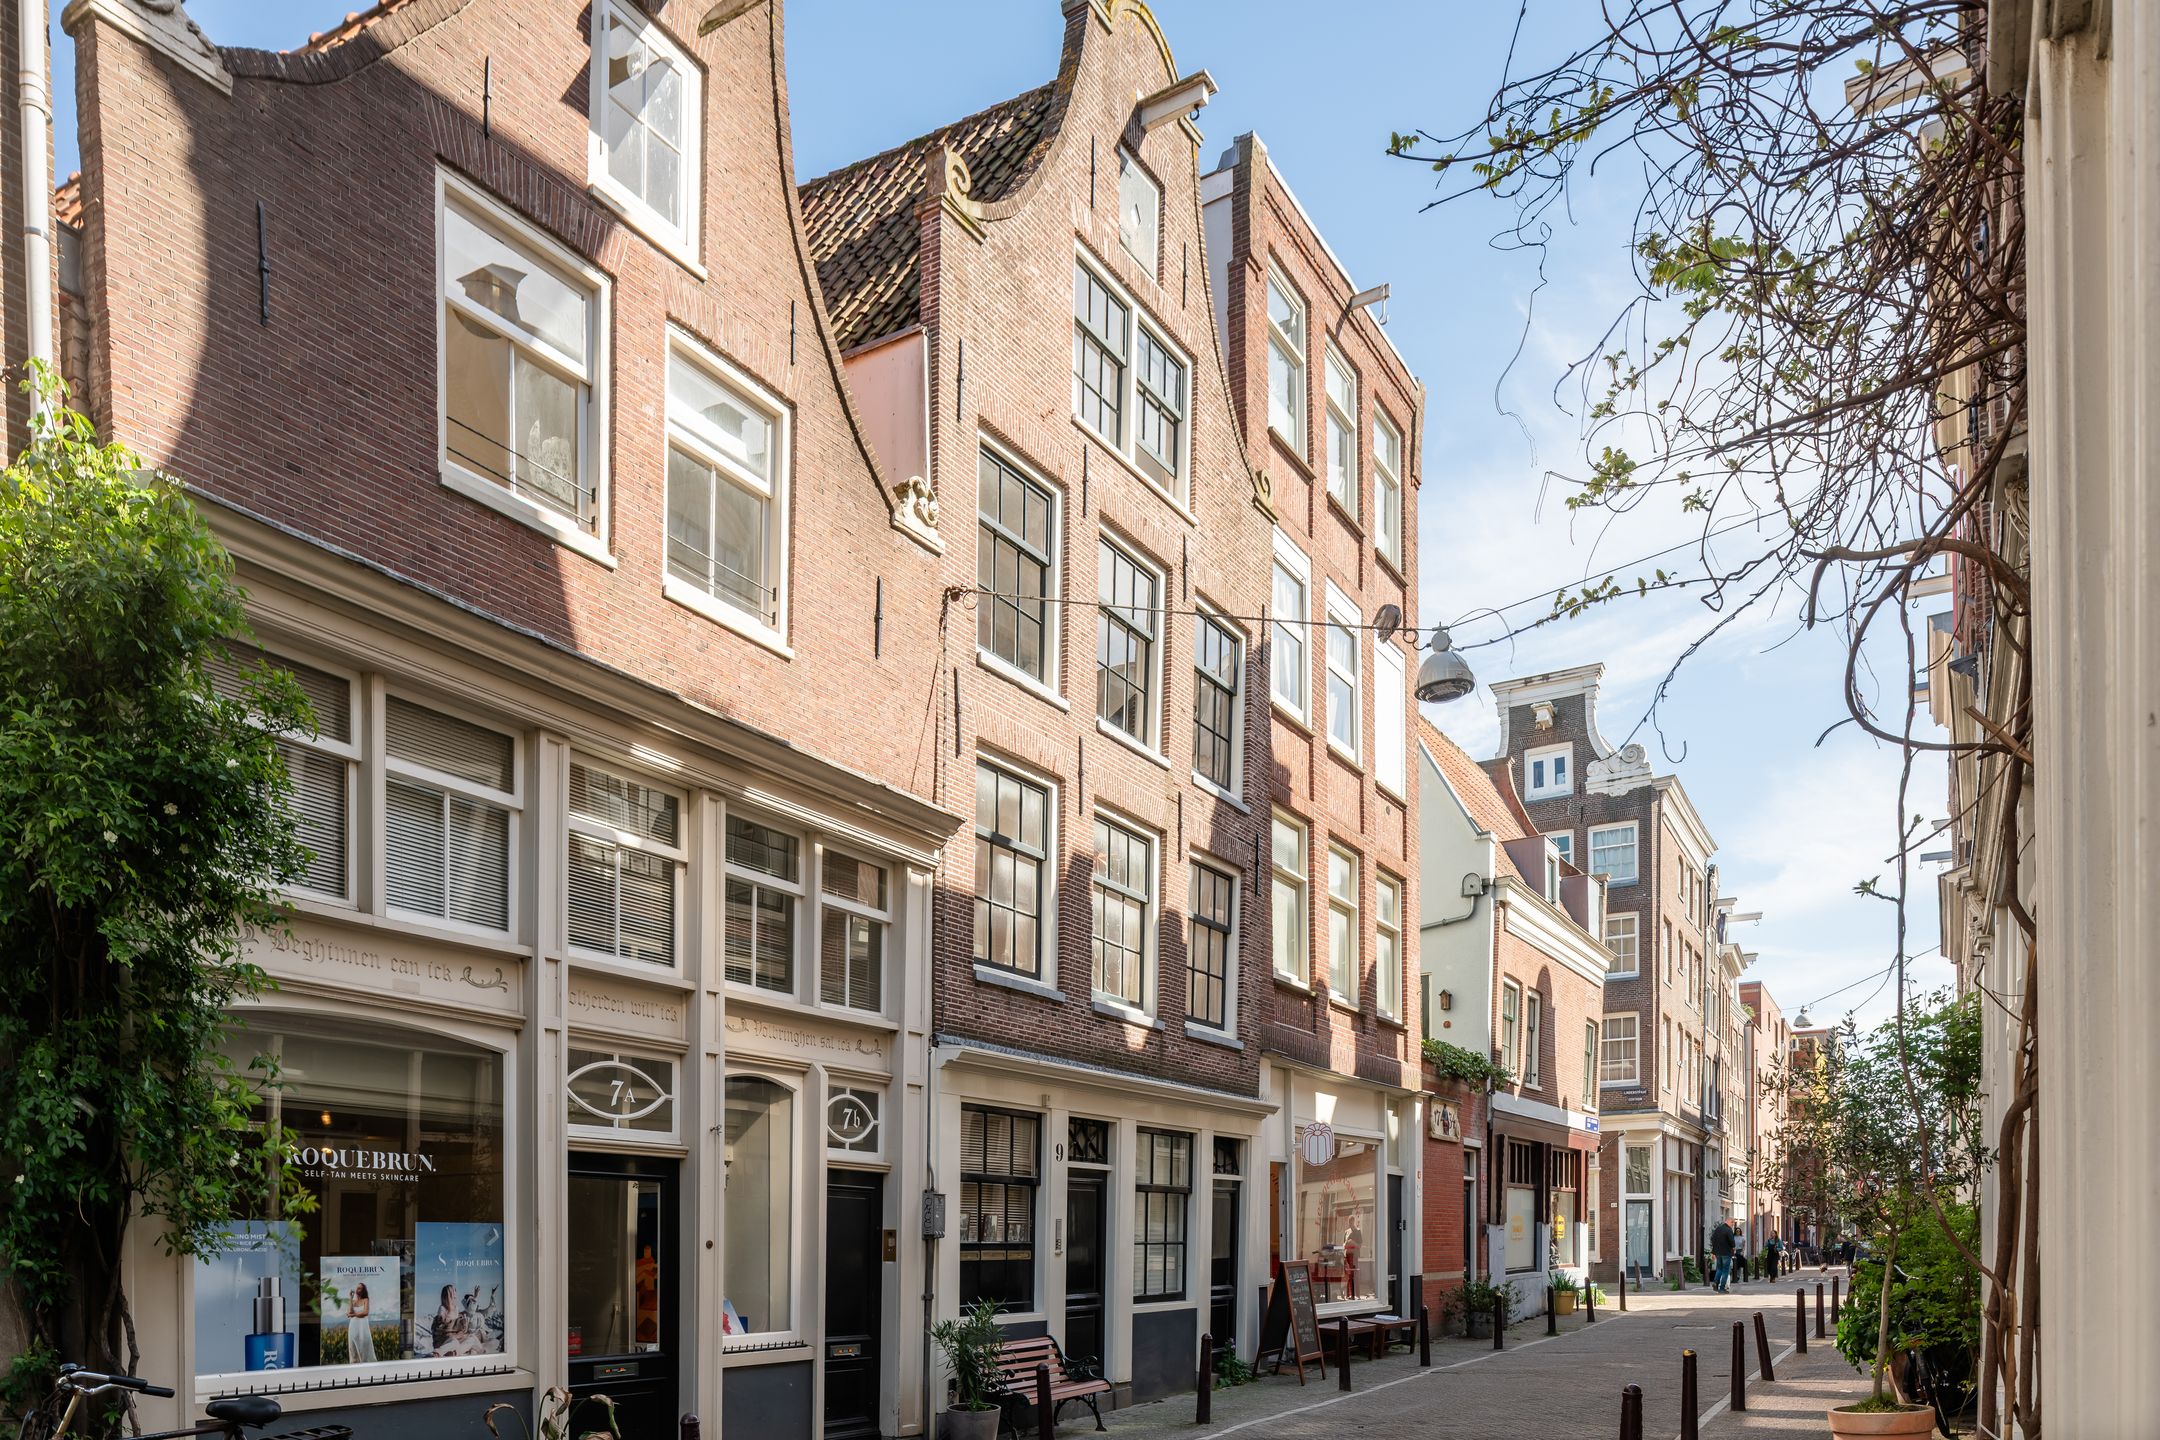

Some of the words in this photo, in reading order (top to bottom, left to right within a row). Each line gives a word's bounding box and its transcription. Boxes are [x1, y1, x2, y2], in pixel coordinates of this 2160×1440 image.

[428, 961, 453, 982] ick
[843, 1107, 860, 1130] 7b
[1055, 1143, 1064, 1162] 9
[304, 1169, 346, 1179] SELF-TAN
[350, 1171, 377, 1180] MEETS
[380, 1173, 420, 1182] SKINCARE
